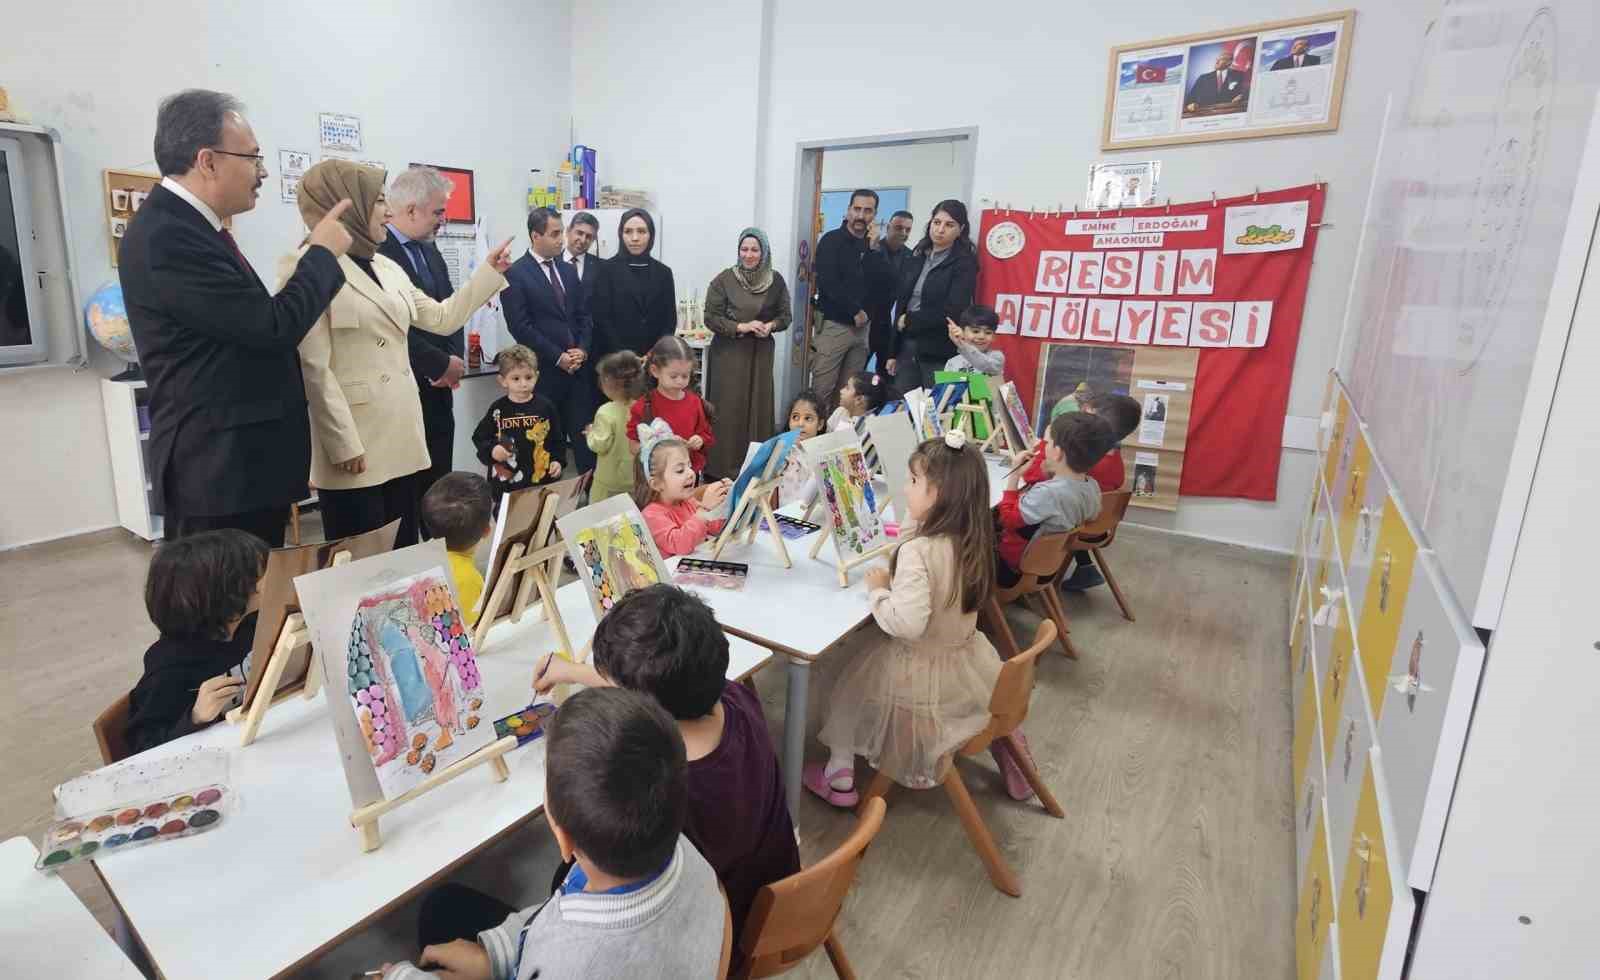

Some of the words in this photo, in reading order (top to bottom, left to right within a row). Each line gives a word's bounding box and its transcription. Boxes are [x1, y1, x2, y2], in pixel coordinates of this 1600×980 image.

[1137, 218, 1199, 230] ERDOĞAN
[1096, 235, 1161, 246] ANAOKULU
[1040, 255, 1213, 290] RESİM
[999, 299, 1259, 345] ATÖLYESİ
